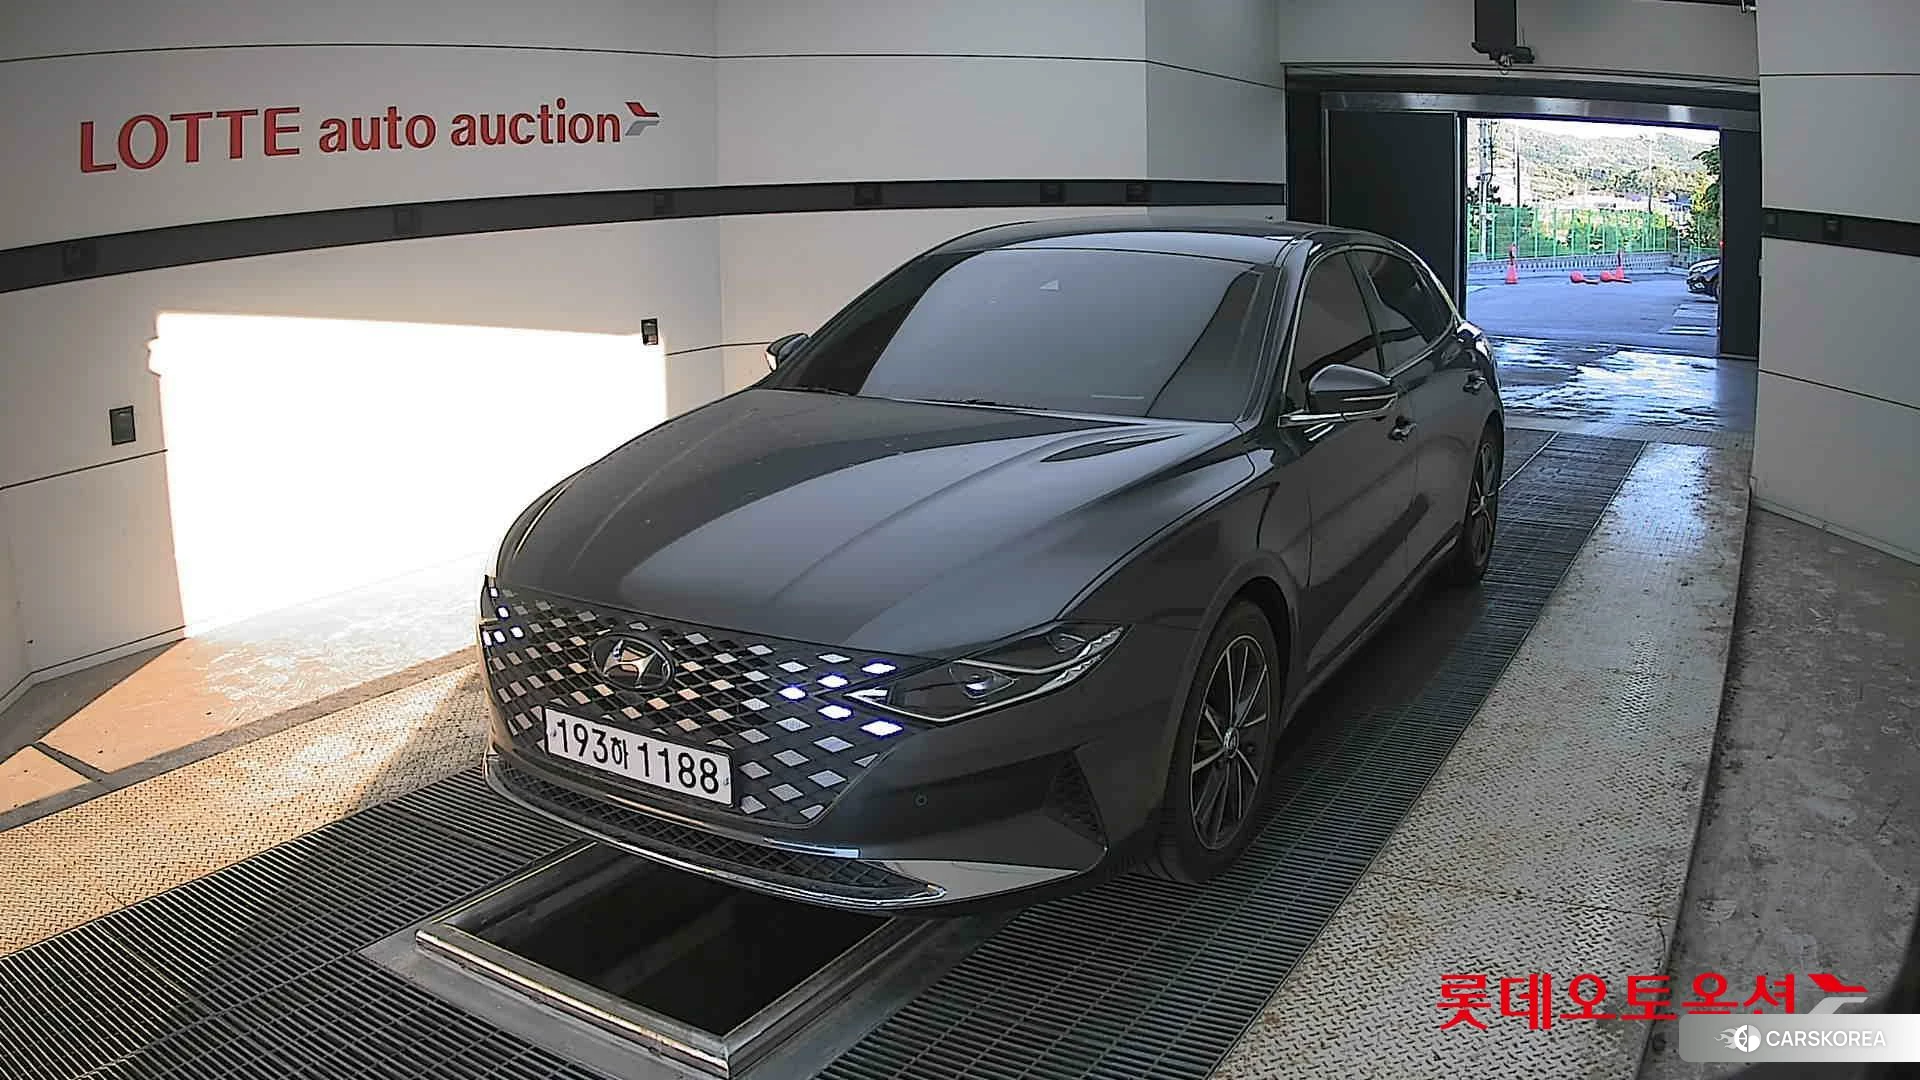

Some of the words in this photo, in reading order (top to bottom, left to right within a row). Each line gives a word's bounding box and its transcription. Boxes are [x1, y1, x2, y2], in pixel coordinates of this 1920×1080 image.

[81, 107, 300, 173] LOTTE
[319, 106, 437, 153] auto
[451, 98, 622, 147] auction
[637, 742, 719, 794] 1188
